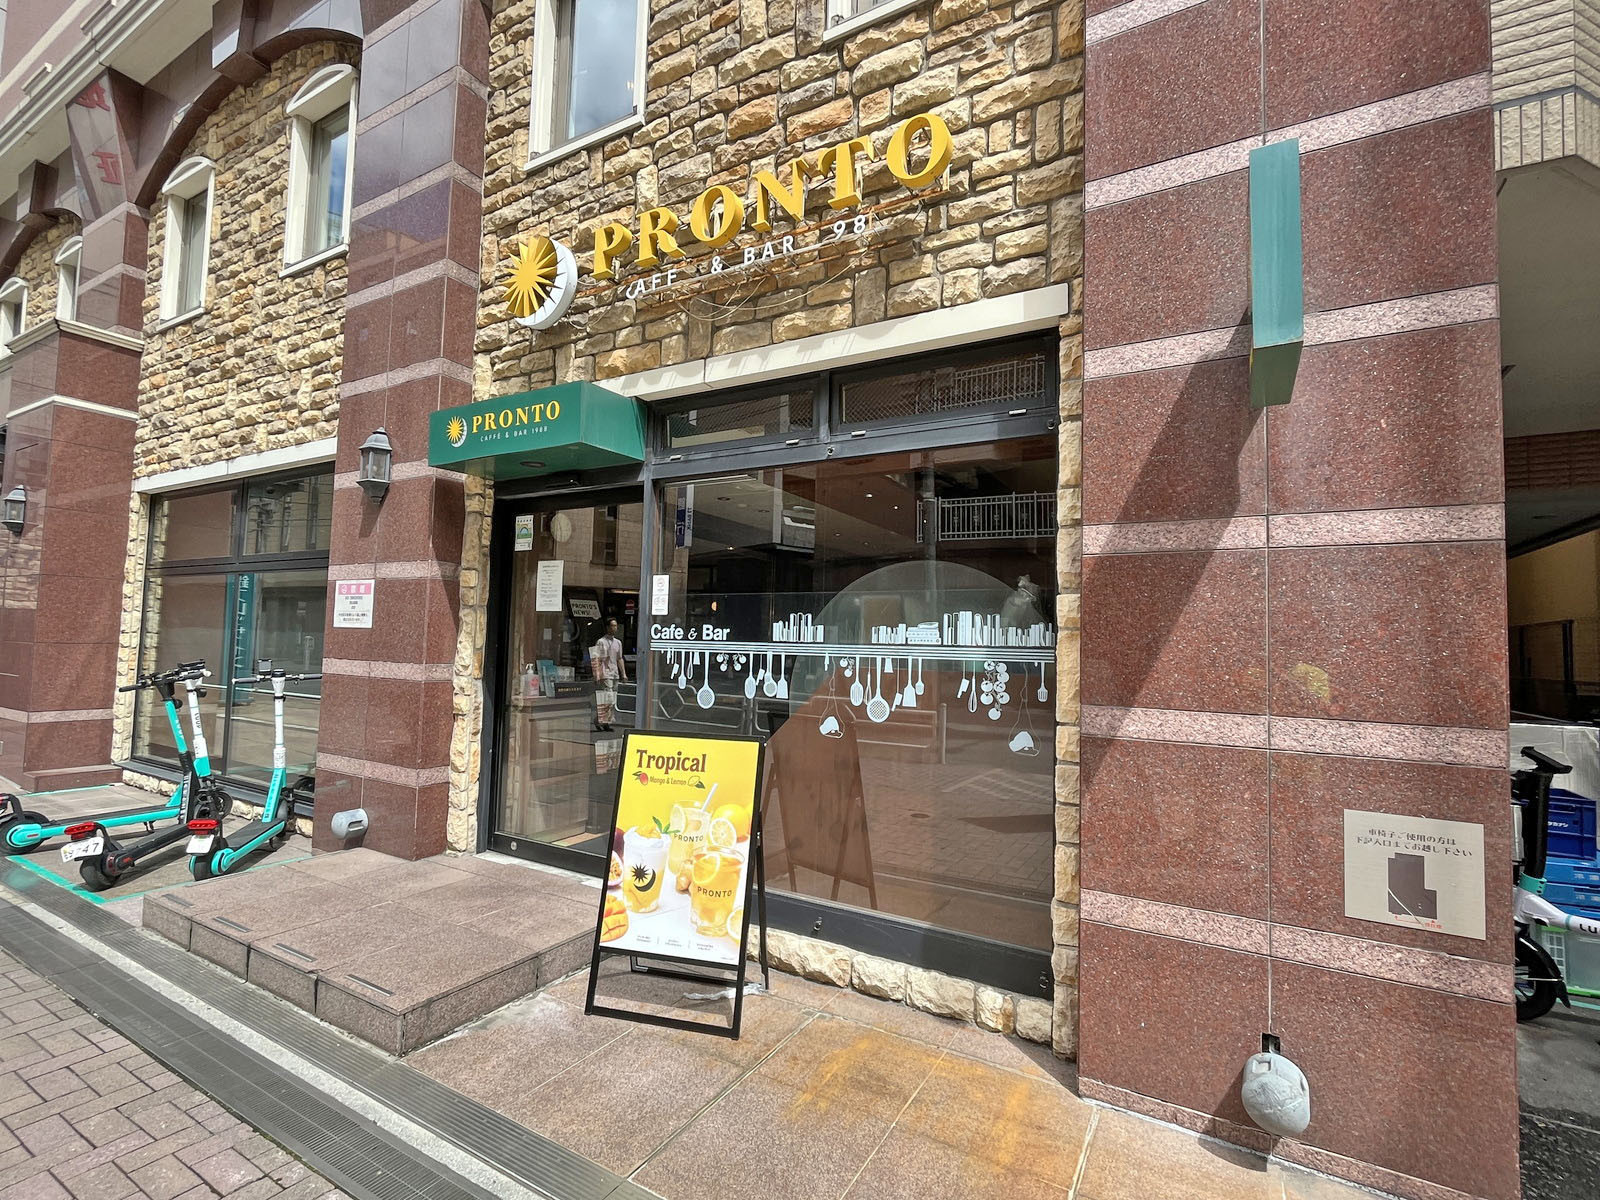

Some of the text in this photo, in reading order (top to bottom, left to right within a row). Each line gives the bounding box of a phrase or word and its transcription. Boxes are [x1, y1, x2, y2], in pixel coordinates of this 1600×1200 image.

[590, 112, 953, 281] PRONTO
[711, 255, 723, 274] &
[743, 235, 795, 265] BAR
[472, 400, 560, 433] PRONTO
[514, 429, 527, 437] BAR
[571, 603, 597, 611] PRONTO'S
[651, 624, 731, 641] Cafe & Bar
[636, 749, 707, 775] Tropical
[650, 776, 666, 786] Mango
[671, 778, 687, 786] Lemon
[674, 833, 704, 843] PRONTO
[697, 886, 733, 898] PRONTO
